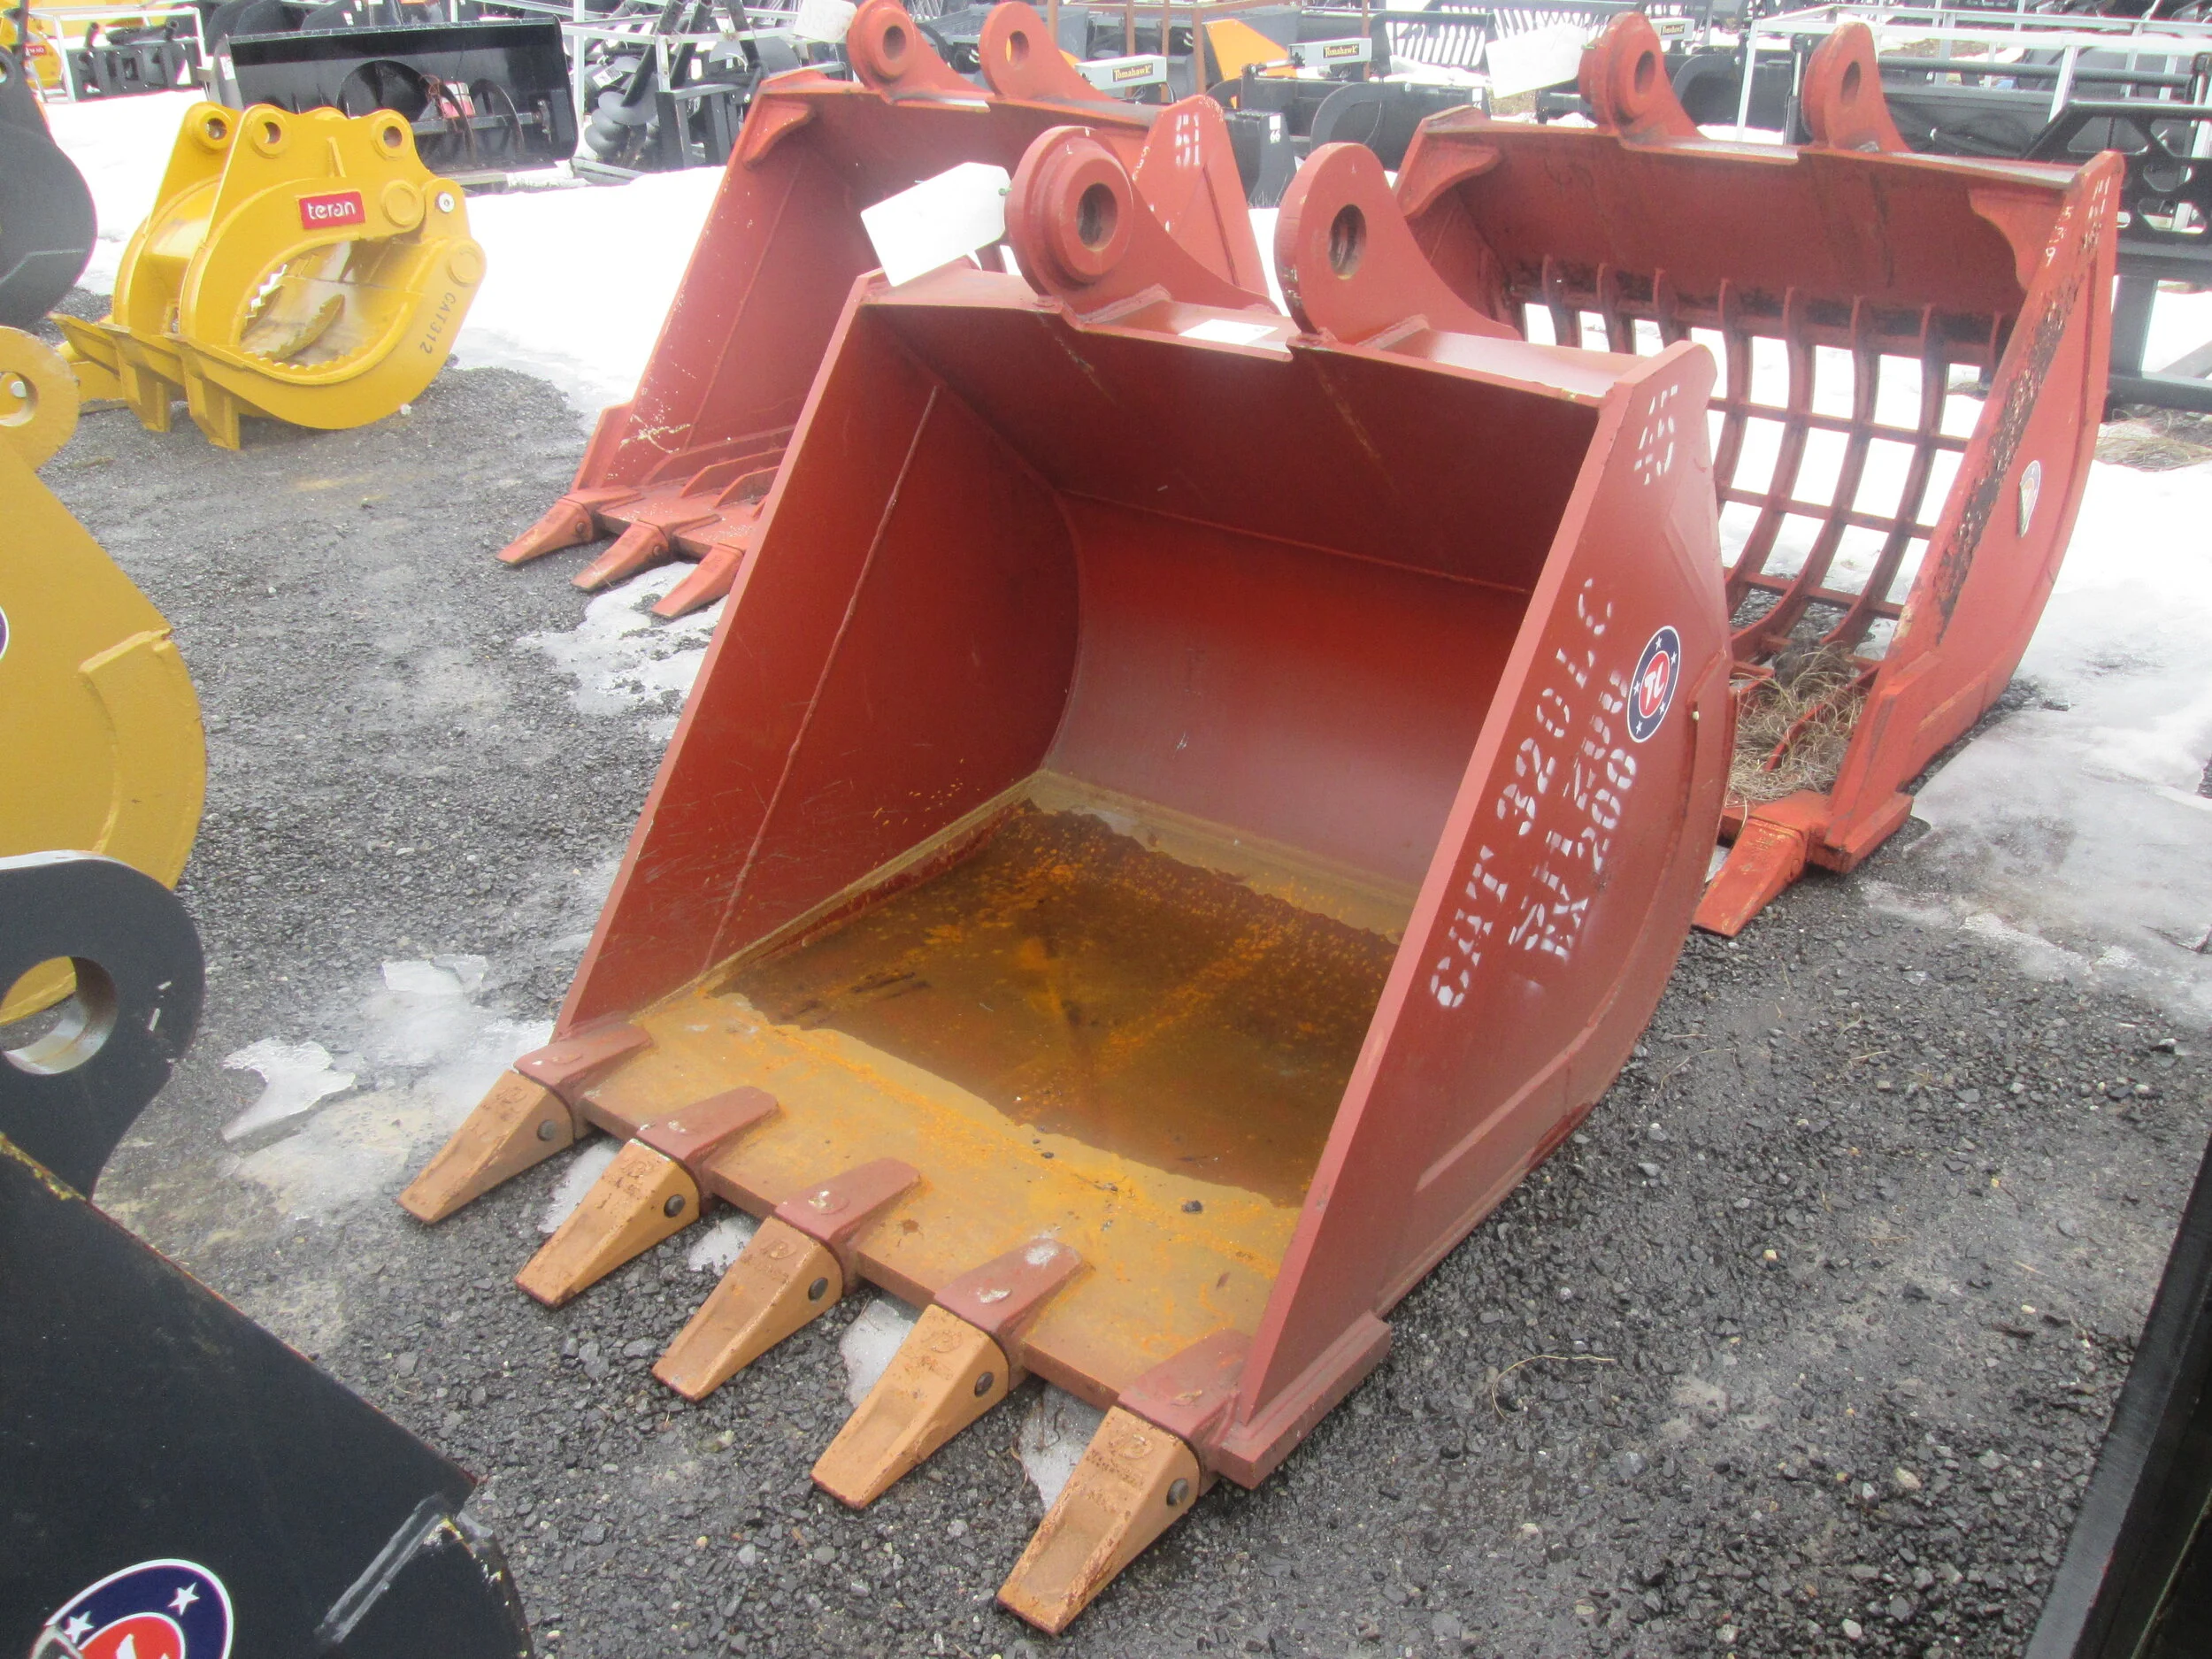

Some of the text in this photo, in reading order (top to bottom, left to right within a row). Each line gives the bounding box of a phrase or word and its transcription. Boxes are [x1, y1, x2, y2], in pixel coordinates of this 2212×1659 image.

[307, 201, 357, 220] teran
[419, 292, 457, 354] CAT312
[1430, 578, 1613, 1009] CAT 320LC
[1539, 748, 1638, 962] EX 200
